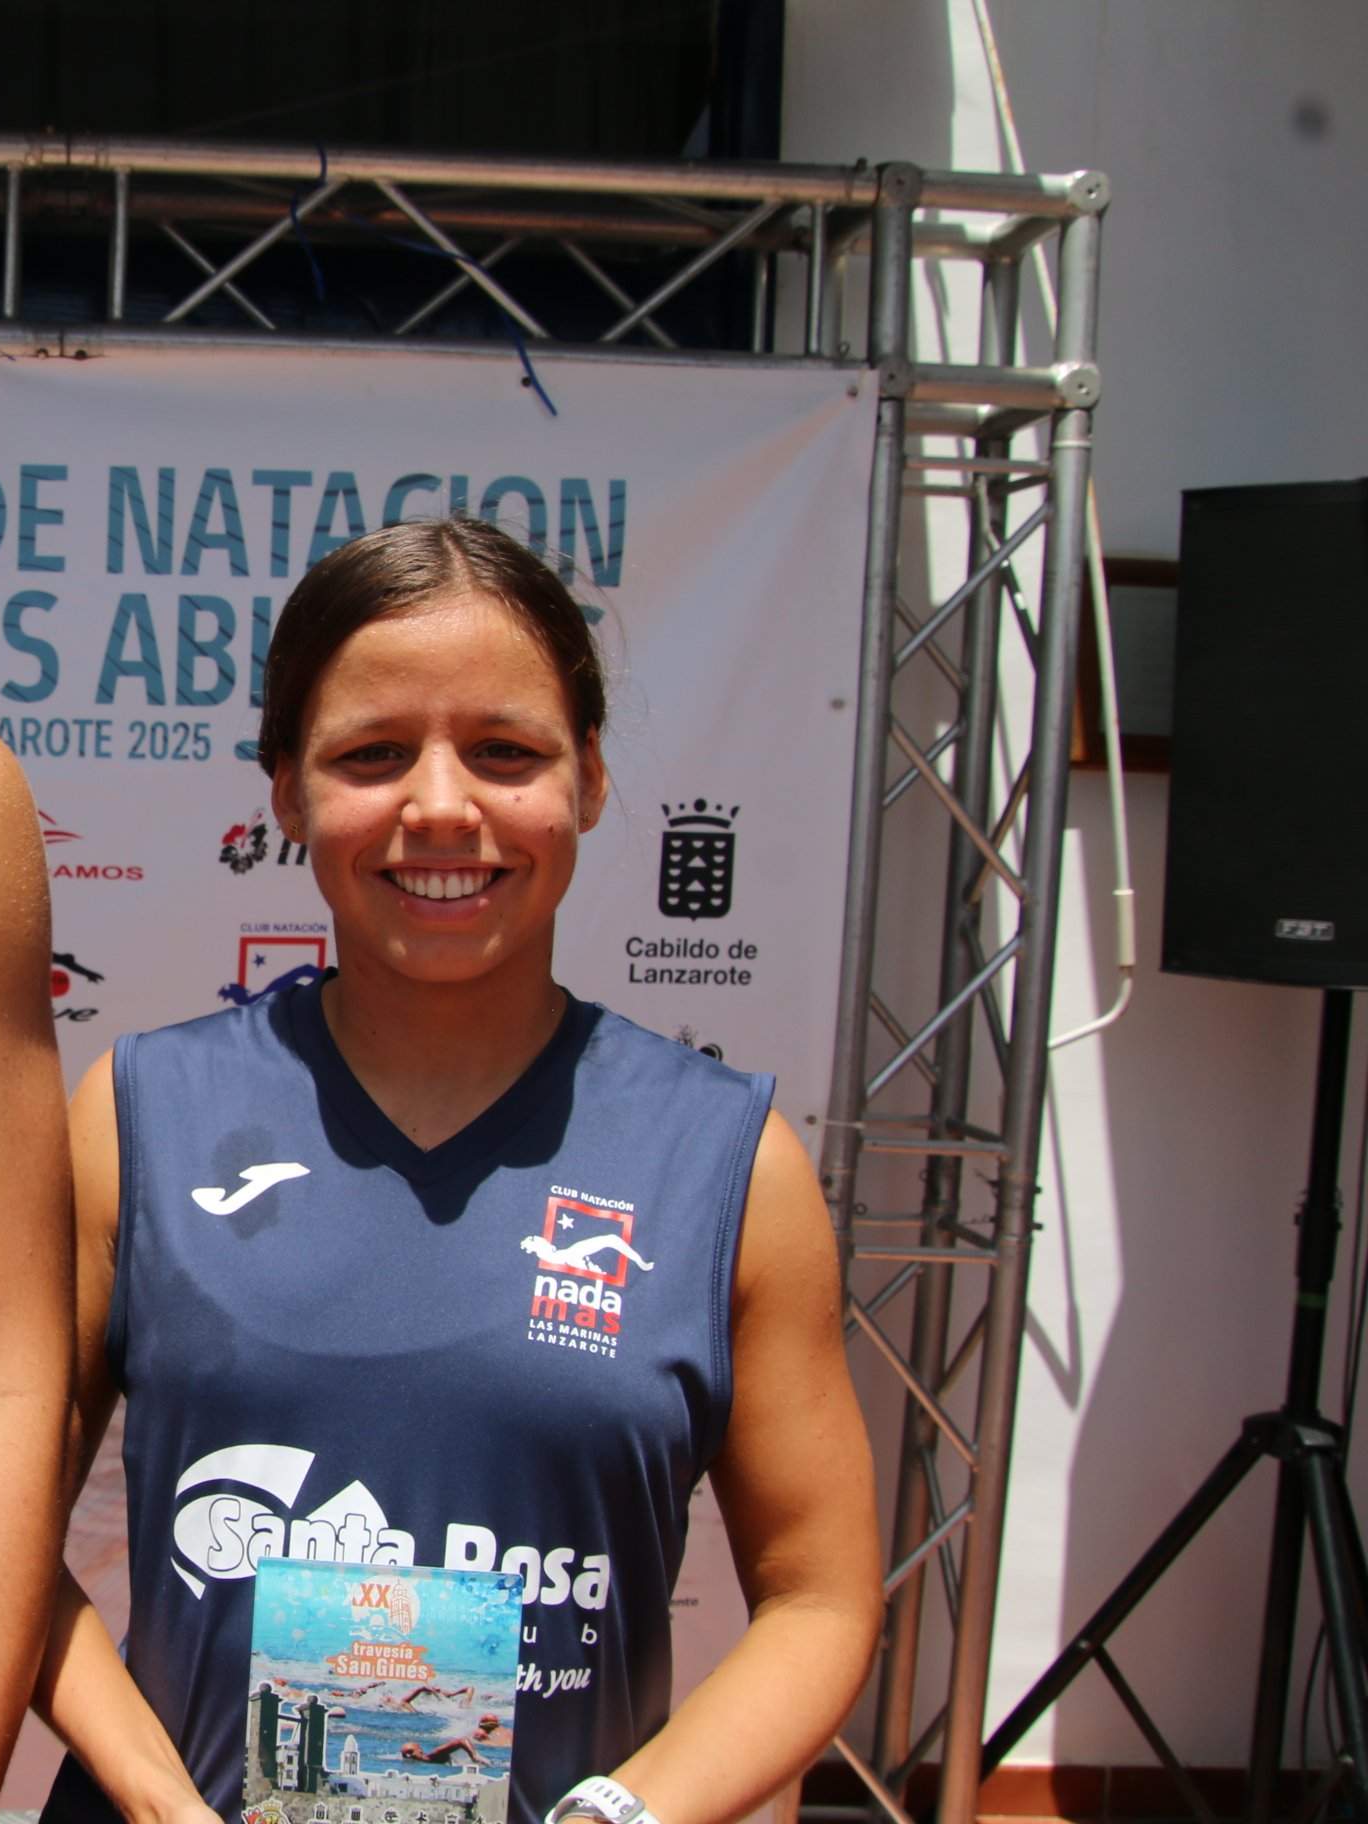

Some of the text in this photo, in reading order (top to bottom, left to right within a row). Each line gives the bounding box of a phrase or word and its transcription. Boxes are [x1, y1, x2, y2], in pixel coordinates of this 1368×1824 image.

[128, 721, 212, 762] 2025
[53, 865, 144, 881] AMOS
[240, 922, 271, 933] CLUB
[625, 936, 759, 961] Cabildo de
[628, 963, 752, 987] Lanzarote
[550, 1185, 635, 1213] CLUB NATACIÓN
[534, 1275, 622, 1316] nada
[527, 1330, 617, 1359] LANZAROTE
[529, 1318, 618, 1347] LAS MARINAS
[207, 1496, 415, 1572] Santa
[353, 1642, 413, 1659] travesía
[337, 1655, 429, 1680] San Ginés
[542, 1667, 592, 1699] you
